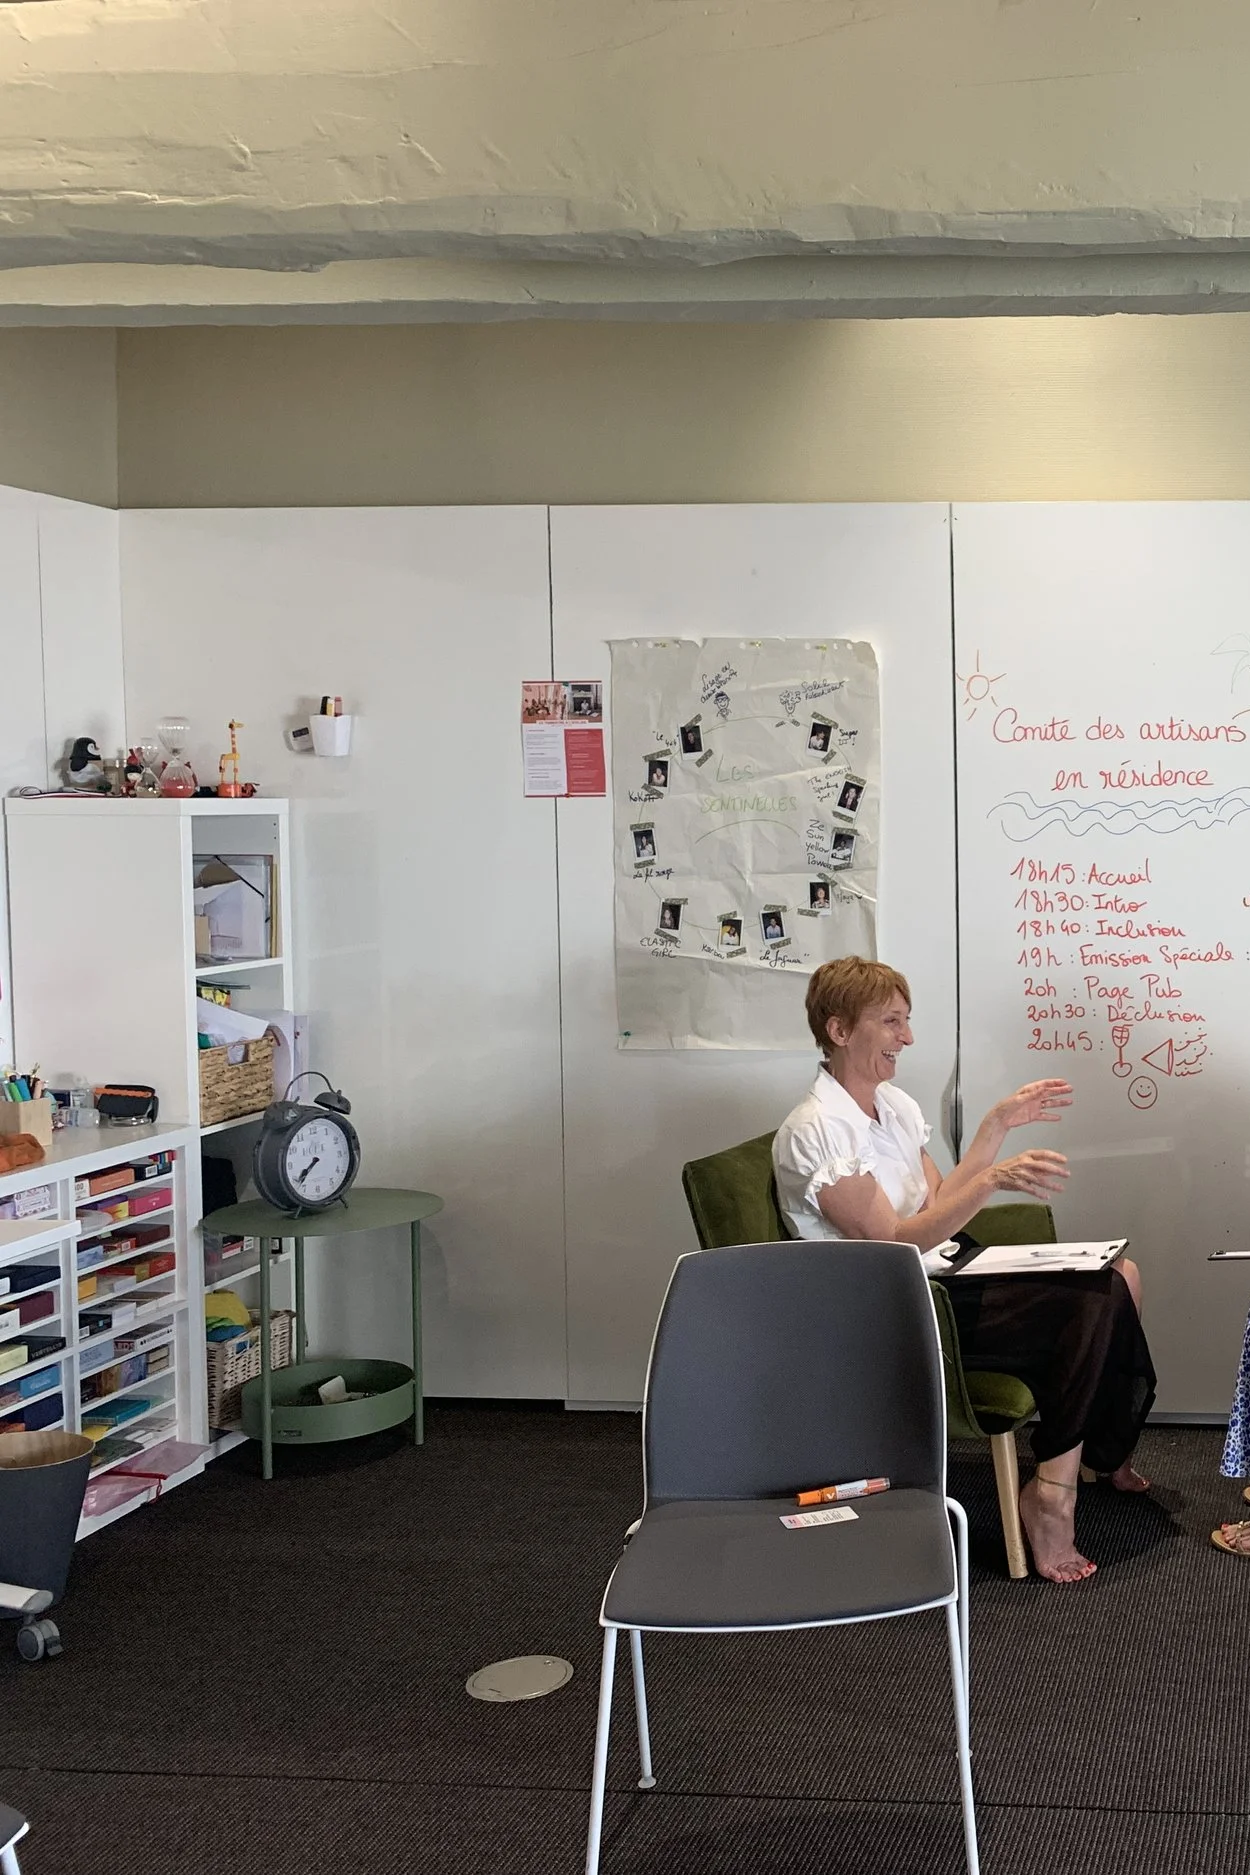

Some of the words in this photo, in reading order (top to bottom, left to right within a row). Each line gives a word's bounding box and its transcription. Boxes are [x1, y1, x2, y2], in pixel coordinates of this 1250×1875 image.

[993, 707, 1077, 744] Comité
[1086, 716, 1125, 740] des
[1140, 716, 1246, 742] artisans
[1051, 770, 1088, 792] en
[1099, 760, 1214, 790] résidence
[701, 793, 797, 814] SENTINELLES
[806, 830, 824, 842] Sun
[1092, 893, 1148, 914] Intro
[1096, 920, 1186, 939] Inclusion
[1084, 976, 1134, 1009] Page
[1140, 974, 1182, 998] Pub
